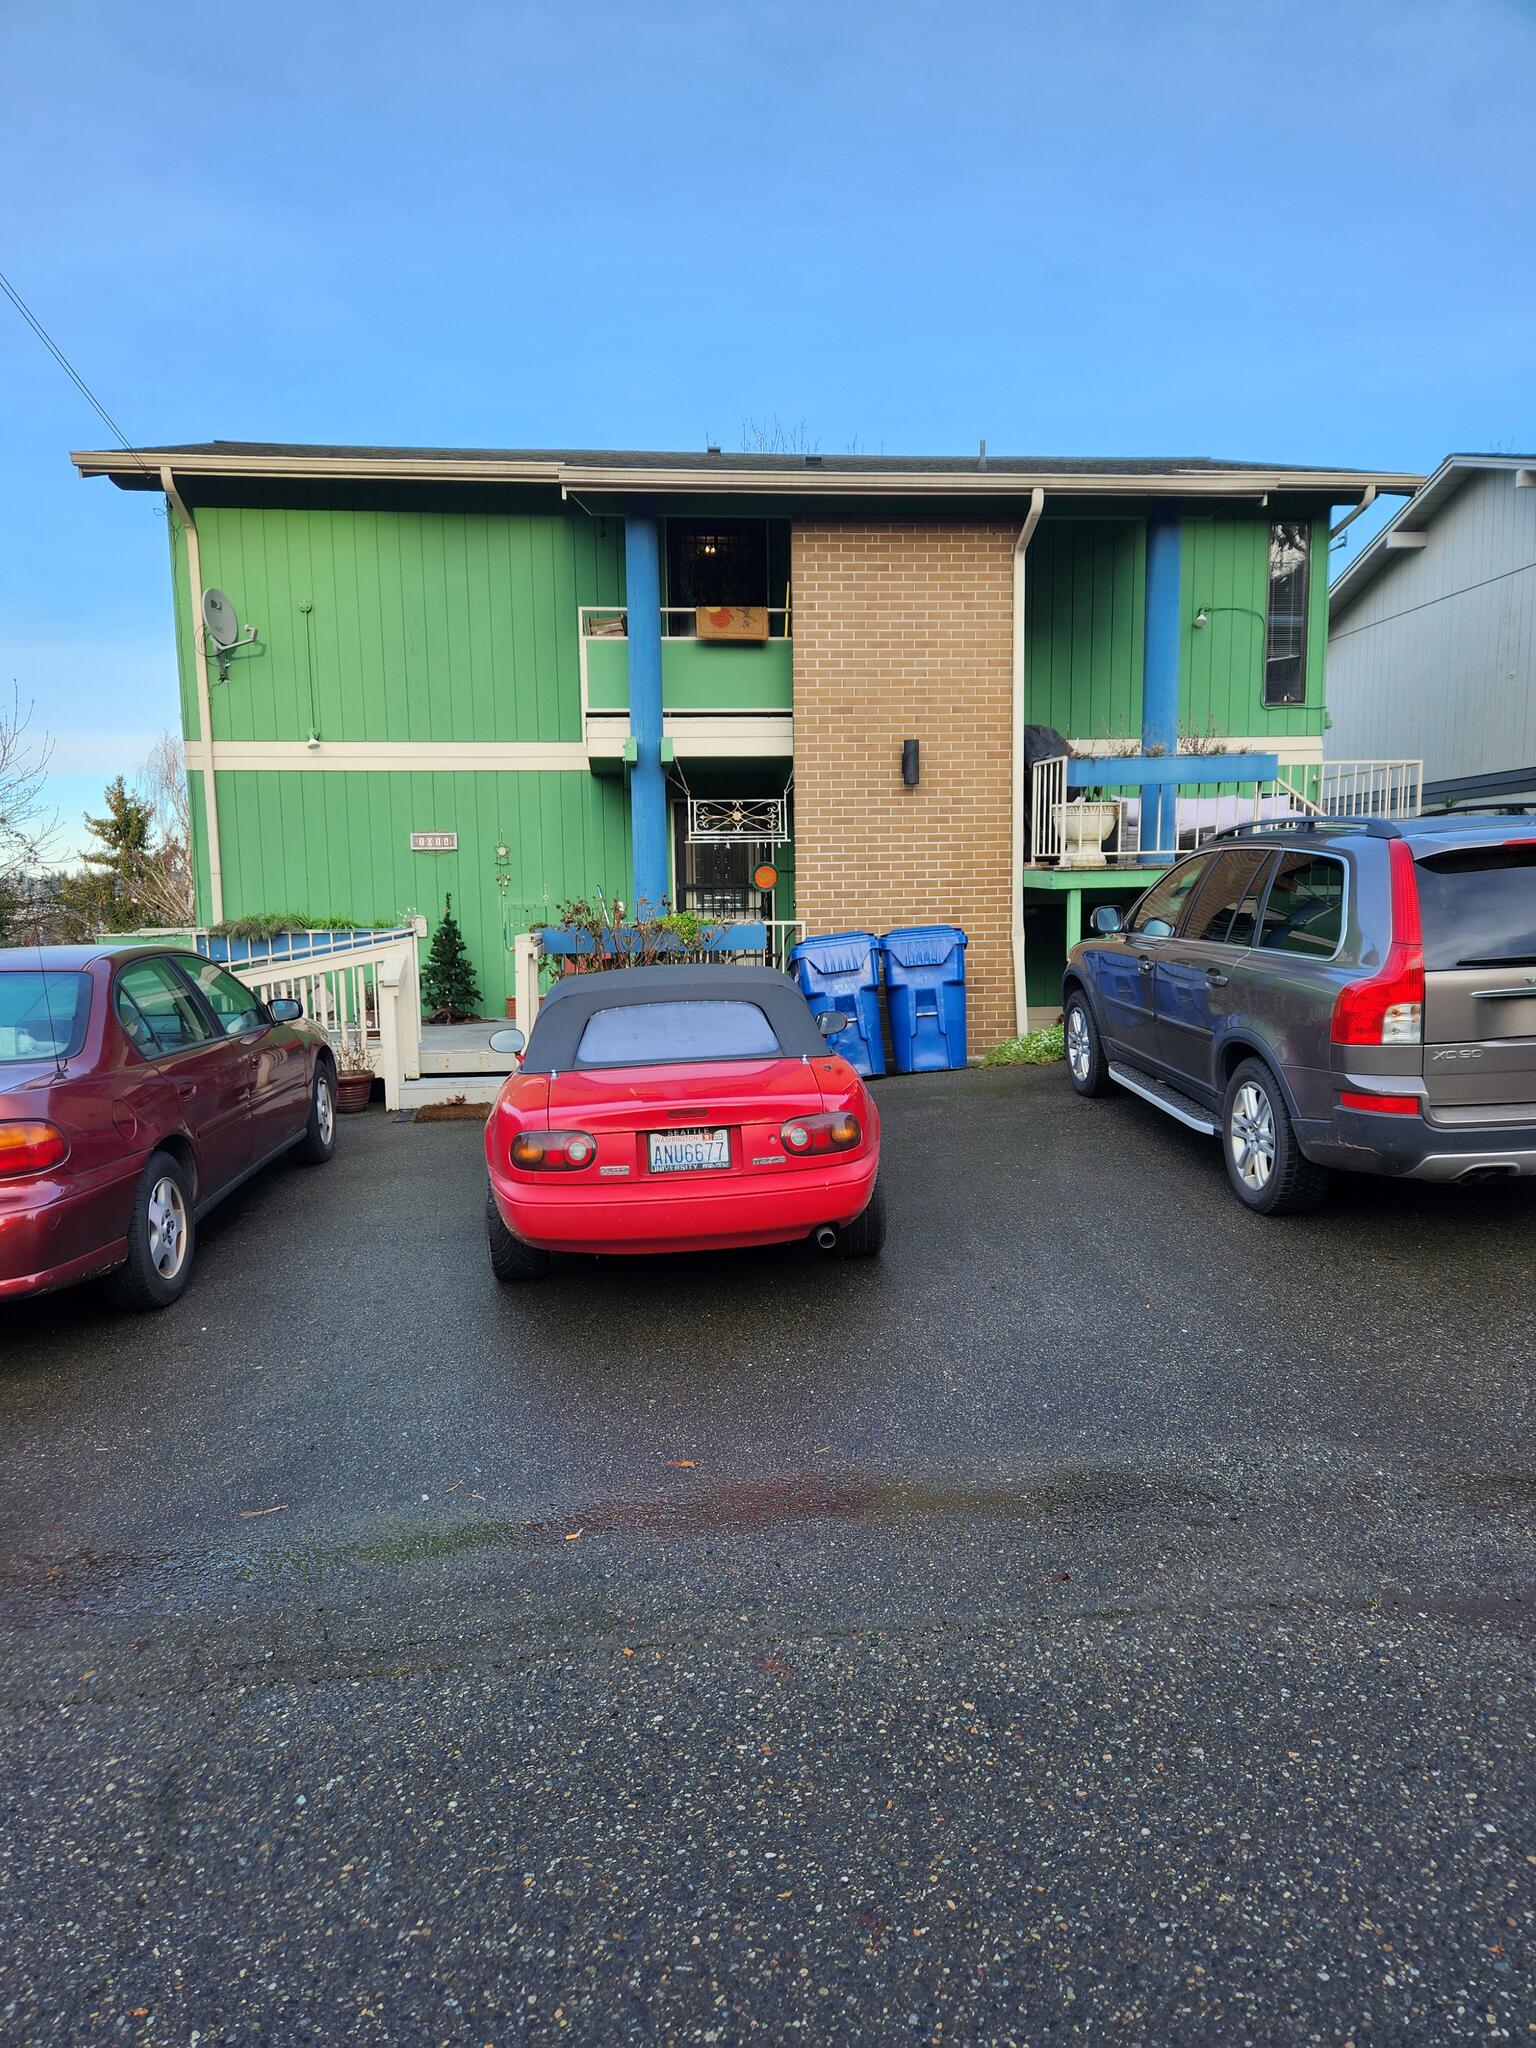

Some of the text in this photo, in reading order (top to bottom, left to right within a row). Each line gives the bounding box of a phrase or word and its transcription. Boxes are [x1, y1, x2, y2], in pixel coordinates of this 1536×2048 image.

[1432, 1049, 1483, 1060] XC90
[667, 1128, 710, 1136] SEATTLE
[655, 1135, 698, 1143] WASHINGTON
[655, 1142, 723, 1164] ANU6677
[651, 1164, 698, 1173] UNIVERSITY
